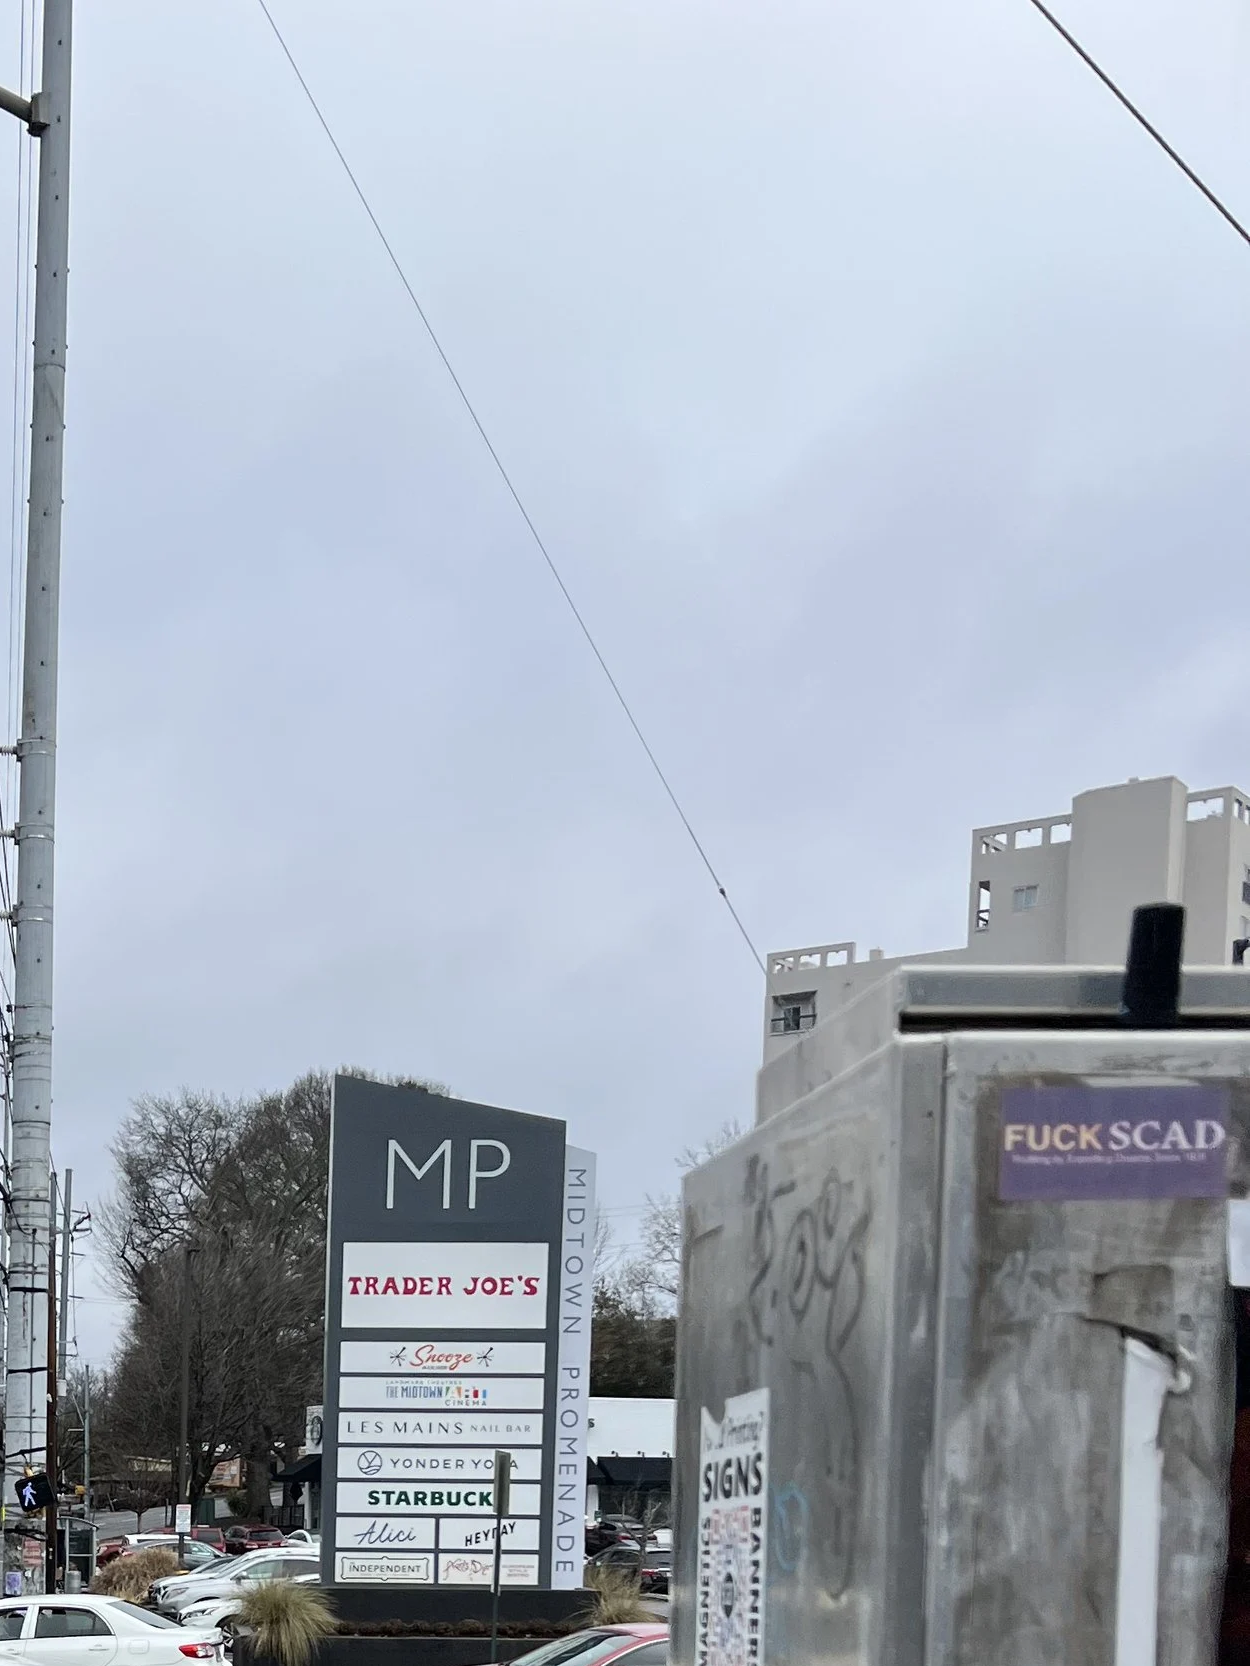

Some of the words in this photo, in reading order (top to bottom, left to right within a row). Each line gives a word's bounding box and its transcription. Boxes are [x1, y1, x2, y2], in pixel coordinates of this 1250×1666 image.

[1004, 1123, 1103, 1152] FUCK
[1108, 1120, 1226, 1151] SCAD
[386, 1139, 511, 1209] MP
[563, 1169, 587, 1334] MIDTOWN
[348, 1277, 452, 1295] TRADER
[463, 1275, 540, 1296] JOE'S
[409, 1344, 473, 1370] Snooze
[385, 1386, 399, 1398] THE
[401, 1386, 443, 1398] MIDTOWN
[347, 1421, 384, 1434] LES
[393, 1421, 463, 1435] MAINS
[470, 1424, 501, 1432] NAIL
[506, 1424, 531, 1433] BAR
[390, 1458, 464, 1469] YONDER
[472, 1458, 518, 1470] YOA
[555, 1367, 580, 1573] PROMENADE
[703, 1453, 762, 1502] SIGNS
[368, 1490, 494, 1506] STARBUCK
[354, 1520, 416, 1545] Alici
[349, 1564, 421, 1573] INDEPENDENT
